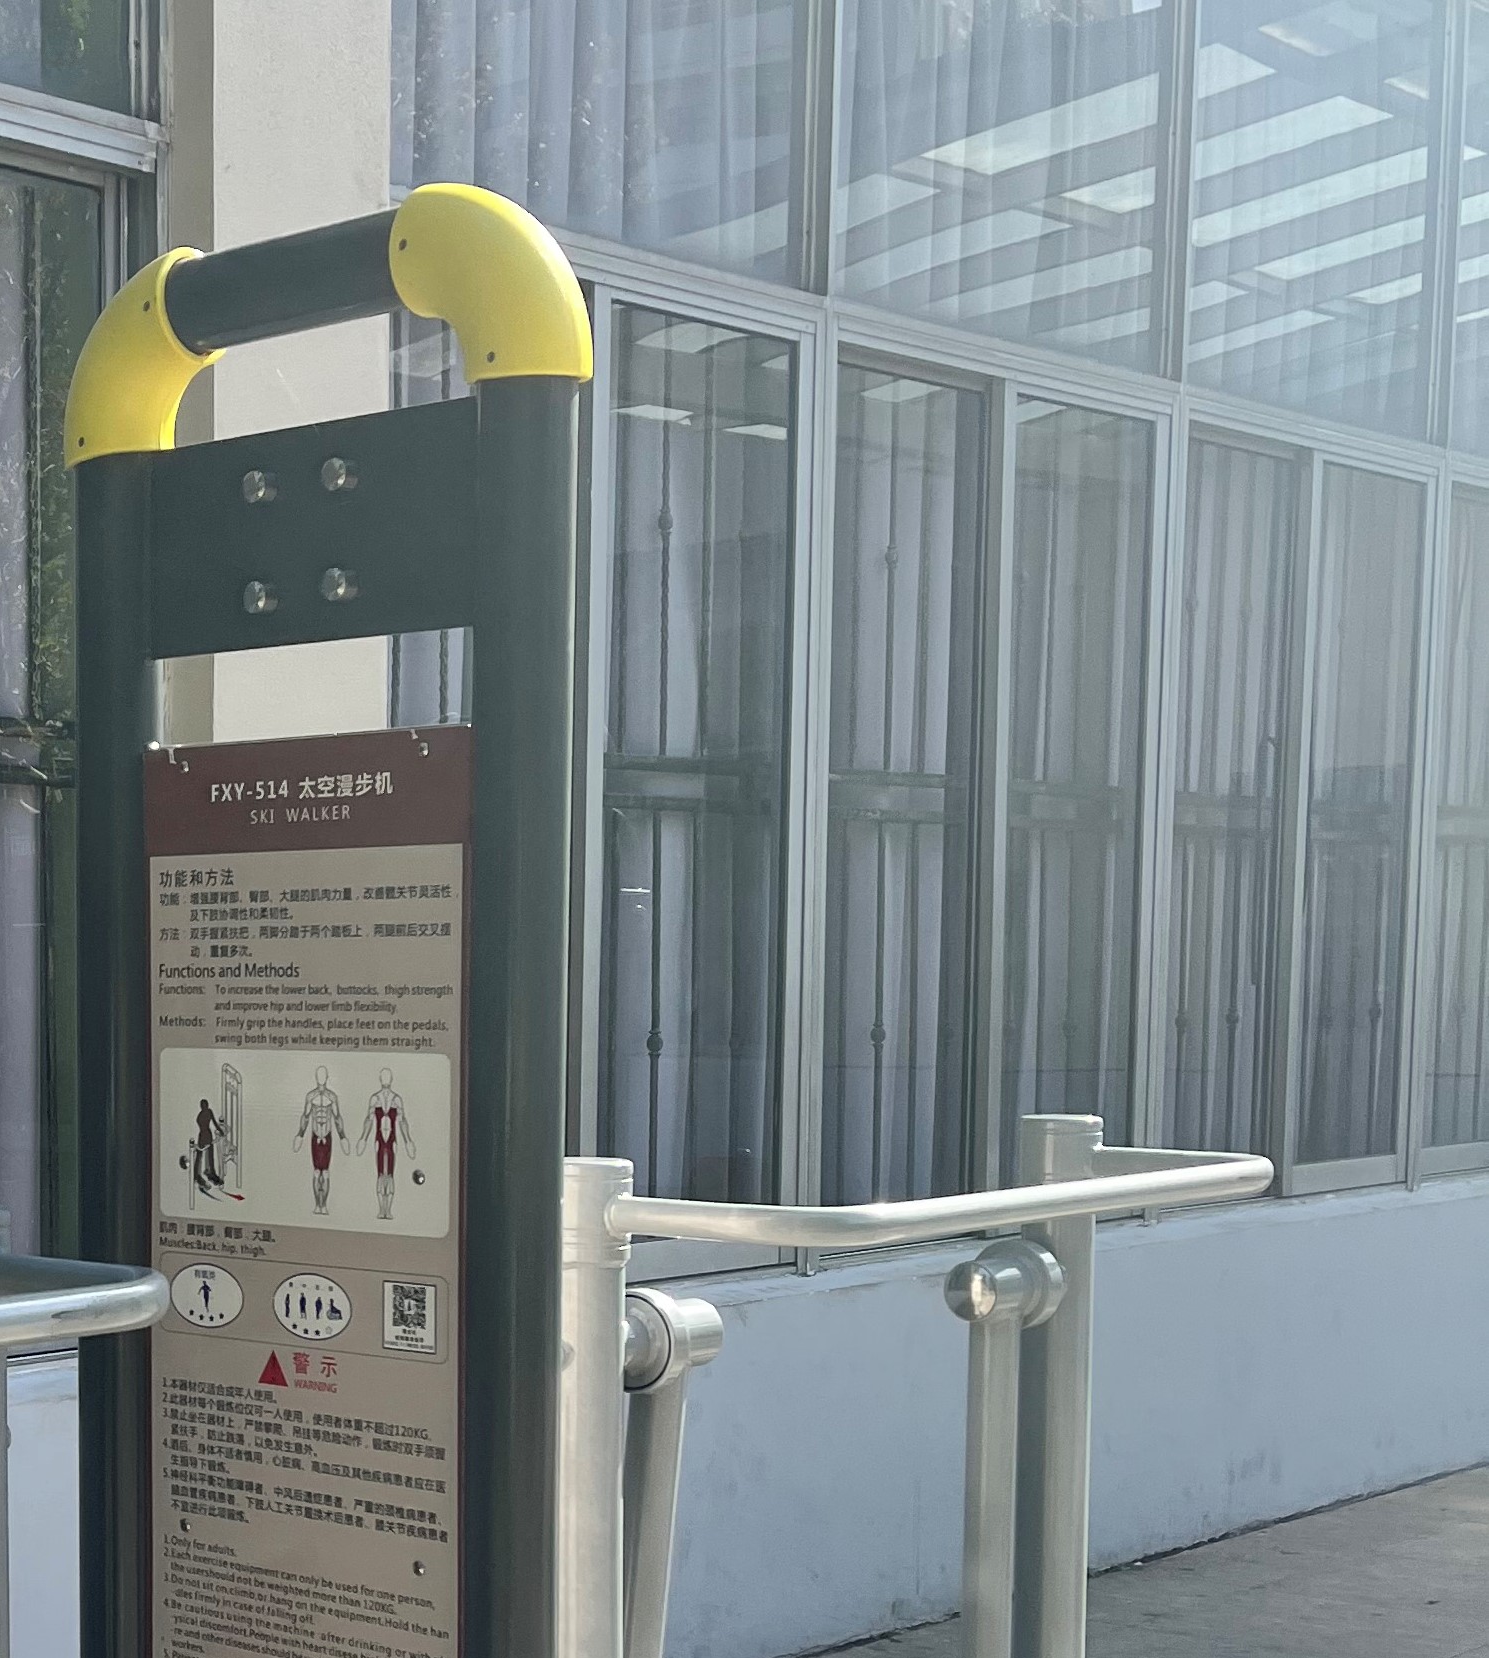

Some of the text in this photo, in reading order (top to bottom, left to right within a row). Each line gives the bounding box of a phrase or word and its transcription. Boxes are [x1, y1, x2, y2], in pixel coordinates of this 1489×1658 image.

[211, 771, 393, 803] FXY-514 太空漫步机
[250, 804, 352, 825] SKI WALKER
[159, 868, 234, 888] 功能和方法
[159, 962, 300, 979] Functions and Methods
[158, 983, 206, 995] Functions:
[215, 984, 226, 995] To
[227, 984, 263, 995] increase
[265, 984, 279, 995] the
[281, 984, 306, 995] lower
[385, 984, 410, 998] thigh
[412, 984, 453, 998] strength
[214, 1001, 352, 1014] and improve hip and lower limb
[216, 1016, 244, 1030] Firmly
[246, 1017, 265, 1031] grip
[267, 1017, 283, 1029] the
[285, 1017, 324, 1030] handles,
[327, 1018, 353, 1032] place
[356, 1018, 375, 1030] feet
[377, 1020, 390, 1030] on
[392, 1018, 409, 1031] the
[411, 1019, 449, 1033] pedals,
[214, 1034, 242, 1047] swing
[244, 1033, 267, 1045] both
[269, 1034, 289, 1048] legs
[291, 1034, 316, 1045] while
[319, 1034, 359, 1049] keeping
[362, 1036, 389, 1048] them
[294, 1378, 337, 1393] WARNING
[164, 1533, 237, 1557] 1.Only for adults.
[164, 1546, 435, 1609] 2.Each exercise equipment can only be used for one person,
[171, 1560, 184, 1572] the
[237, 1575, 252, 1586] not
[254, 1576, 266, 1588] be
[268, 1581, 310, 1597] weighted
[312, 1591, 336, 1602] more
[339, 1593, 360, 1607] than
[164, 1571, 183, 1585] 3.Do
[185, 1578, 200, 1588] not
[203, 1580, 213, 1591] sit
[270, 1592, 293, 1609] hang
[296, 1600, 308, 1610] on
[310, 1600, 325, 1613] the
[412, 1621, 428, 1634] the
[430, 1625, 449, 1638] han
[195, 1590, 220, 1608] firmly
[222, 1596, 231, 1608] in
[233, 1601, 253, 1612] case
[255, 1604, 265, 1615] of
[267, 1605, 296, 1623] falling
[164, 1596, 182, 1610] 4.Be
[185, 1603, 224, 1619] cautious
[226, 1612, 252, 1627] using
[256, 1615, 270, 1629] the
[273, 1622, 315, 1638] machine
[320, 1631, 345, 1645] after
[348, 1635, 392, 1657] drinking
[395, 1648, 406, 1658] or
[184, 1628, 200, 1639] and
[202, 1630, 223, 1644] other
[225, 1634, 260, 1652] diseases
[262, 1644, 290, 1658] should
[281, 1636, 300, 1649] with
[302, 1639, 327, 1654] heart
